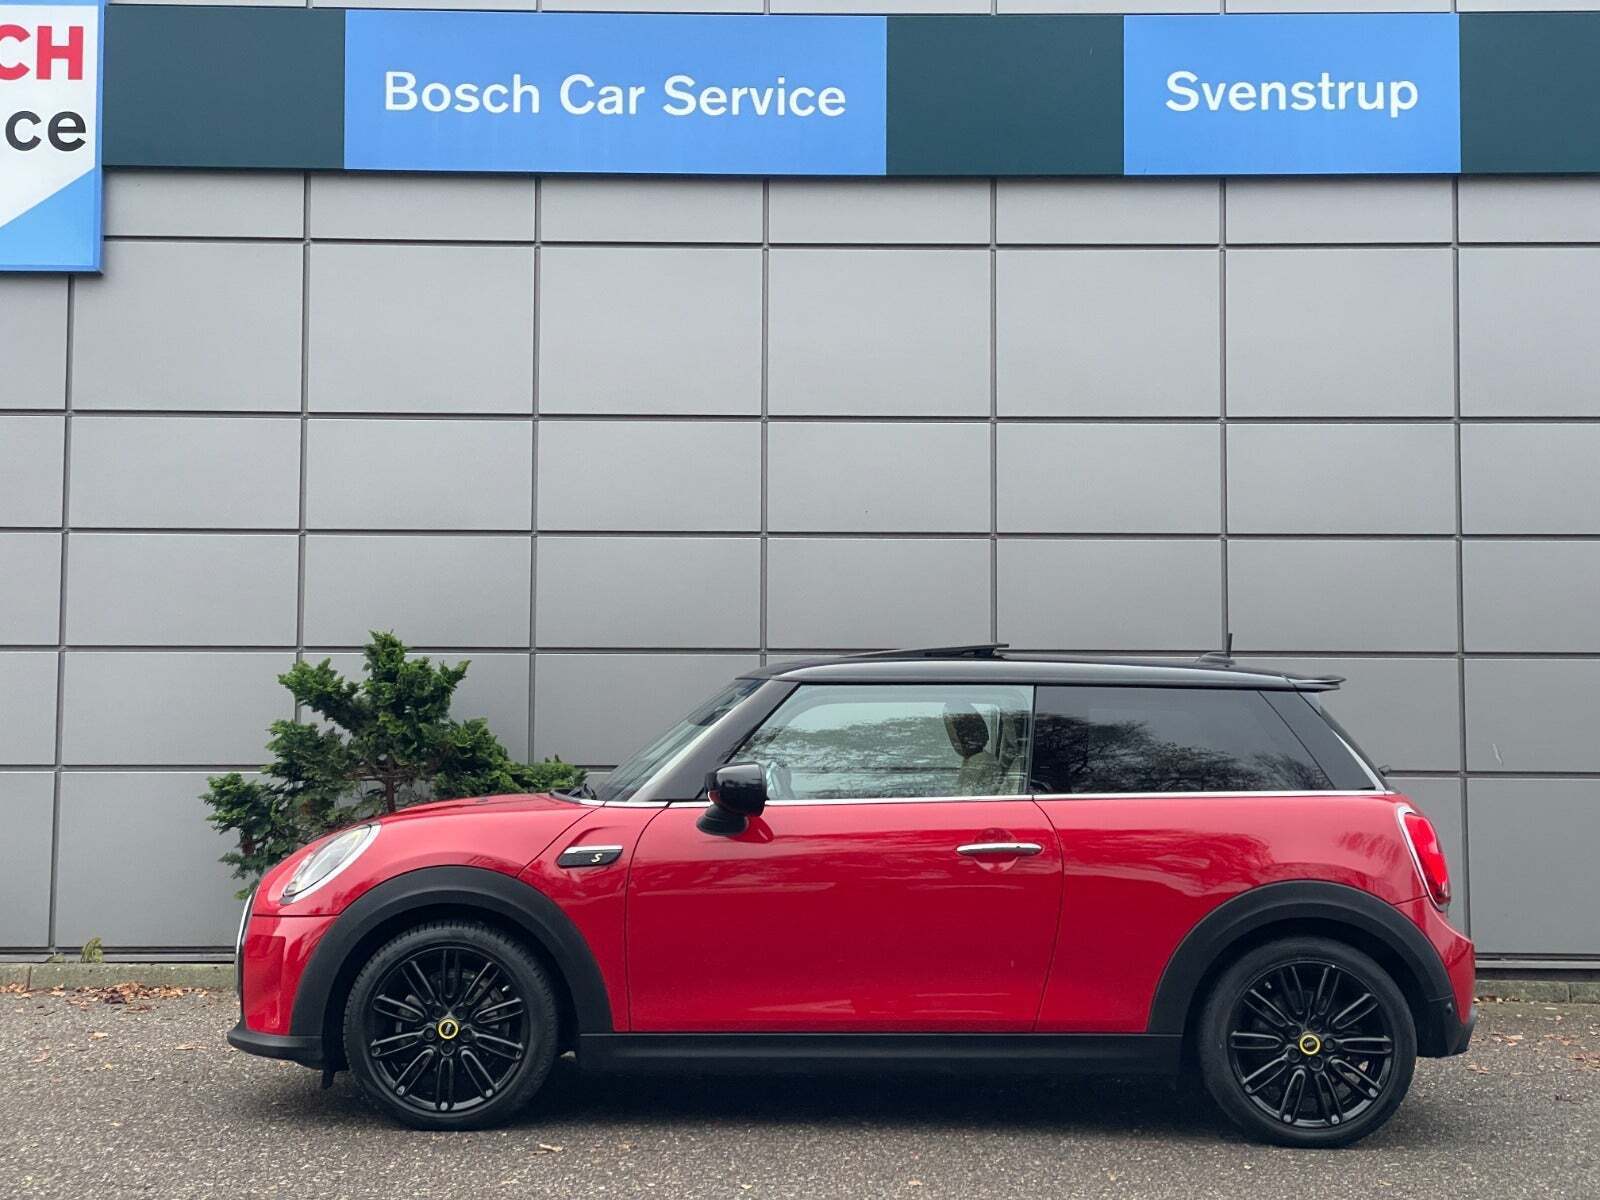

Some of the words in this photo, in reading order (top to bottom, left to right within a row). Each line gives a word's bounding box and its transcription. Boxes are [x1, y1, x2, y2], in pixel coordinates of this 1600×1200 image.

[385, 71, 540, 114] Bosch
[560, 74, 645, 115] Car
[663, 75, 846, 116] Service
[1165, 70, 1418, 118] Svenstrup
[5, 110, 86, 151] ce
[591, 853, 603, 863] S
